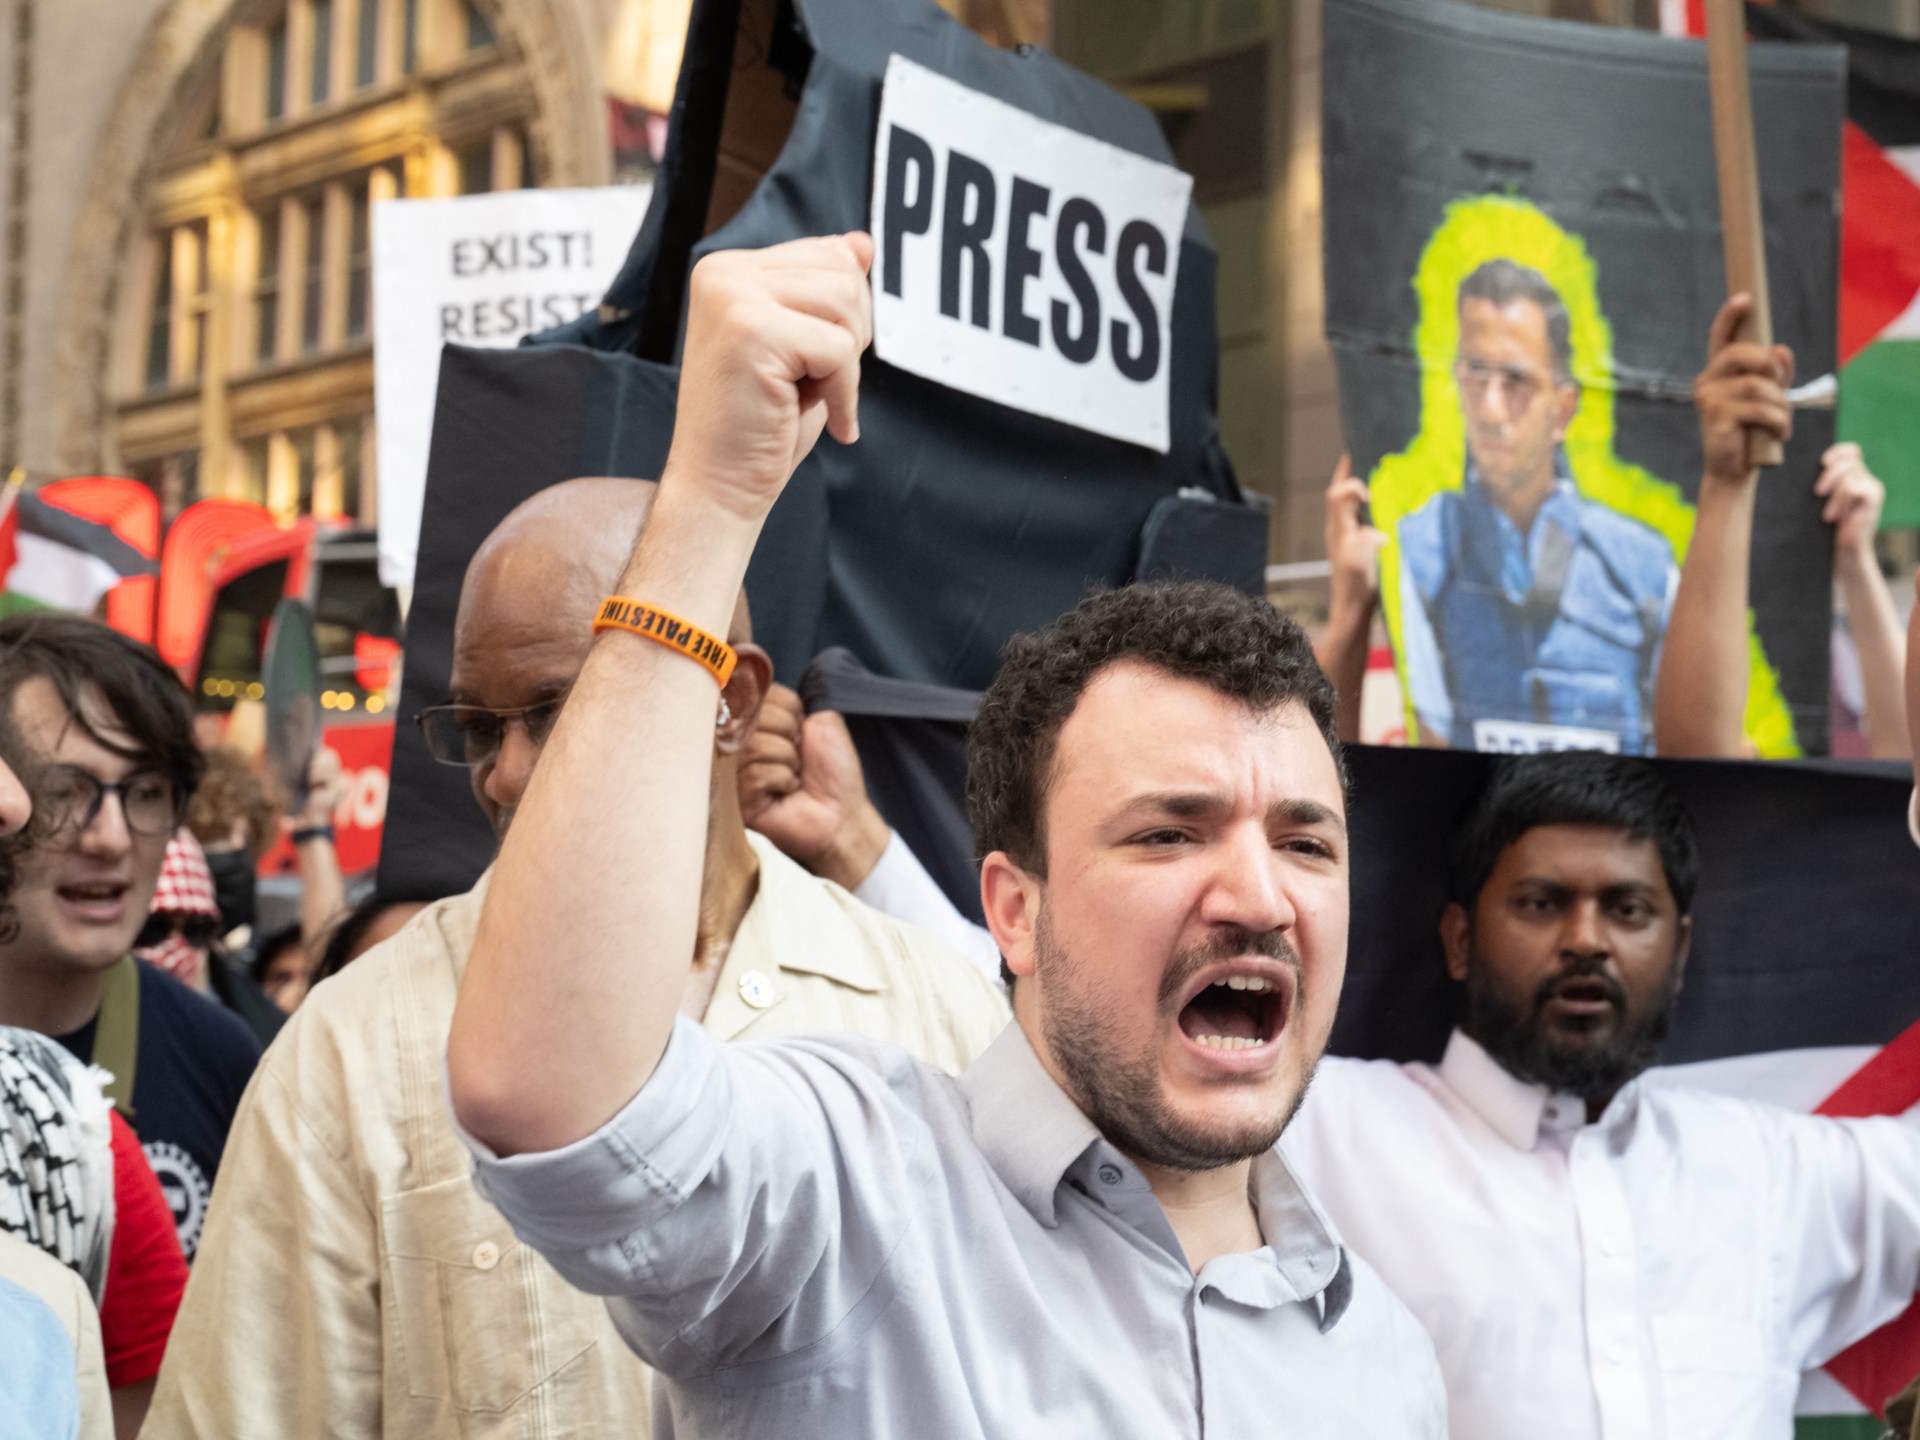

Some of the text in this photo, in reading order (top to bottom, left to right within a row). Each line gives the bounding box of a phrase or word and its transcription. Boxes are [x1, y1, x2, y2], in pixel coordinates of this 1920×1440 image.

[452, 231, 594, 277] EXIST!
[882, 123, 1168, 384] PRESS
[692, 633, 728, 671] FREE
